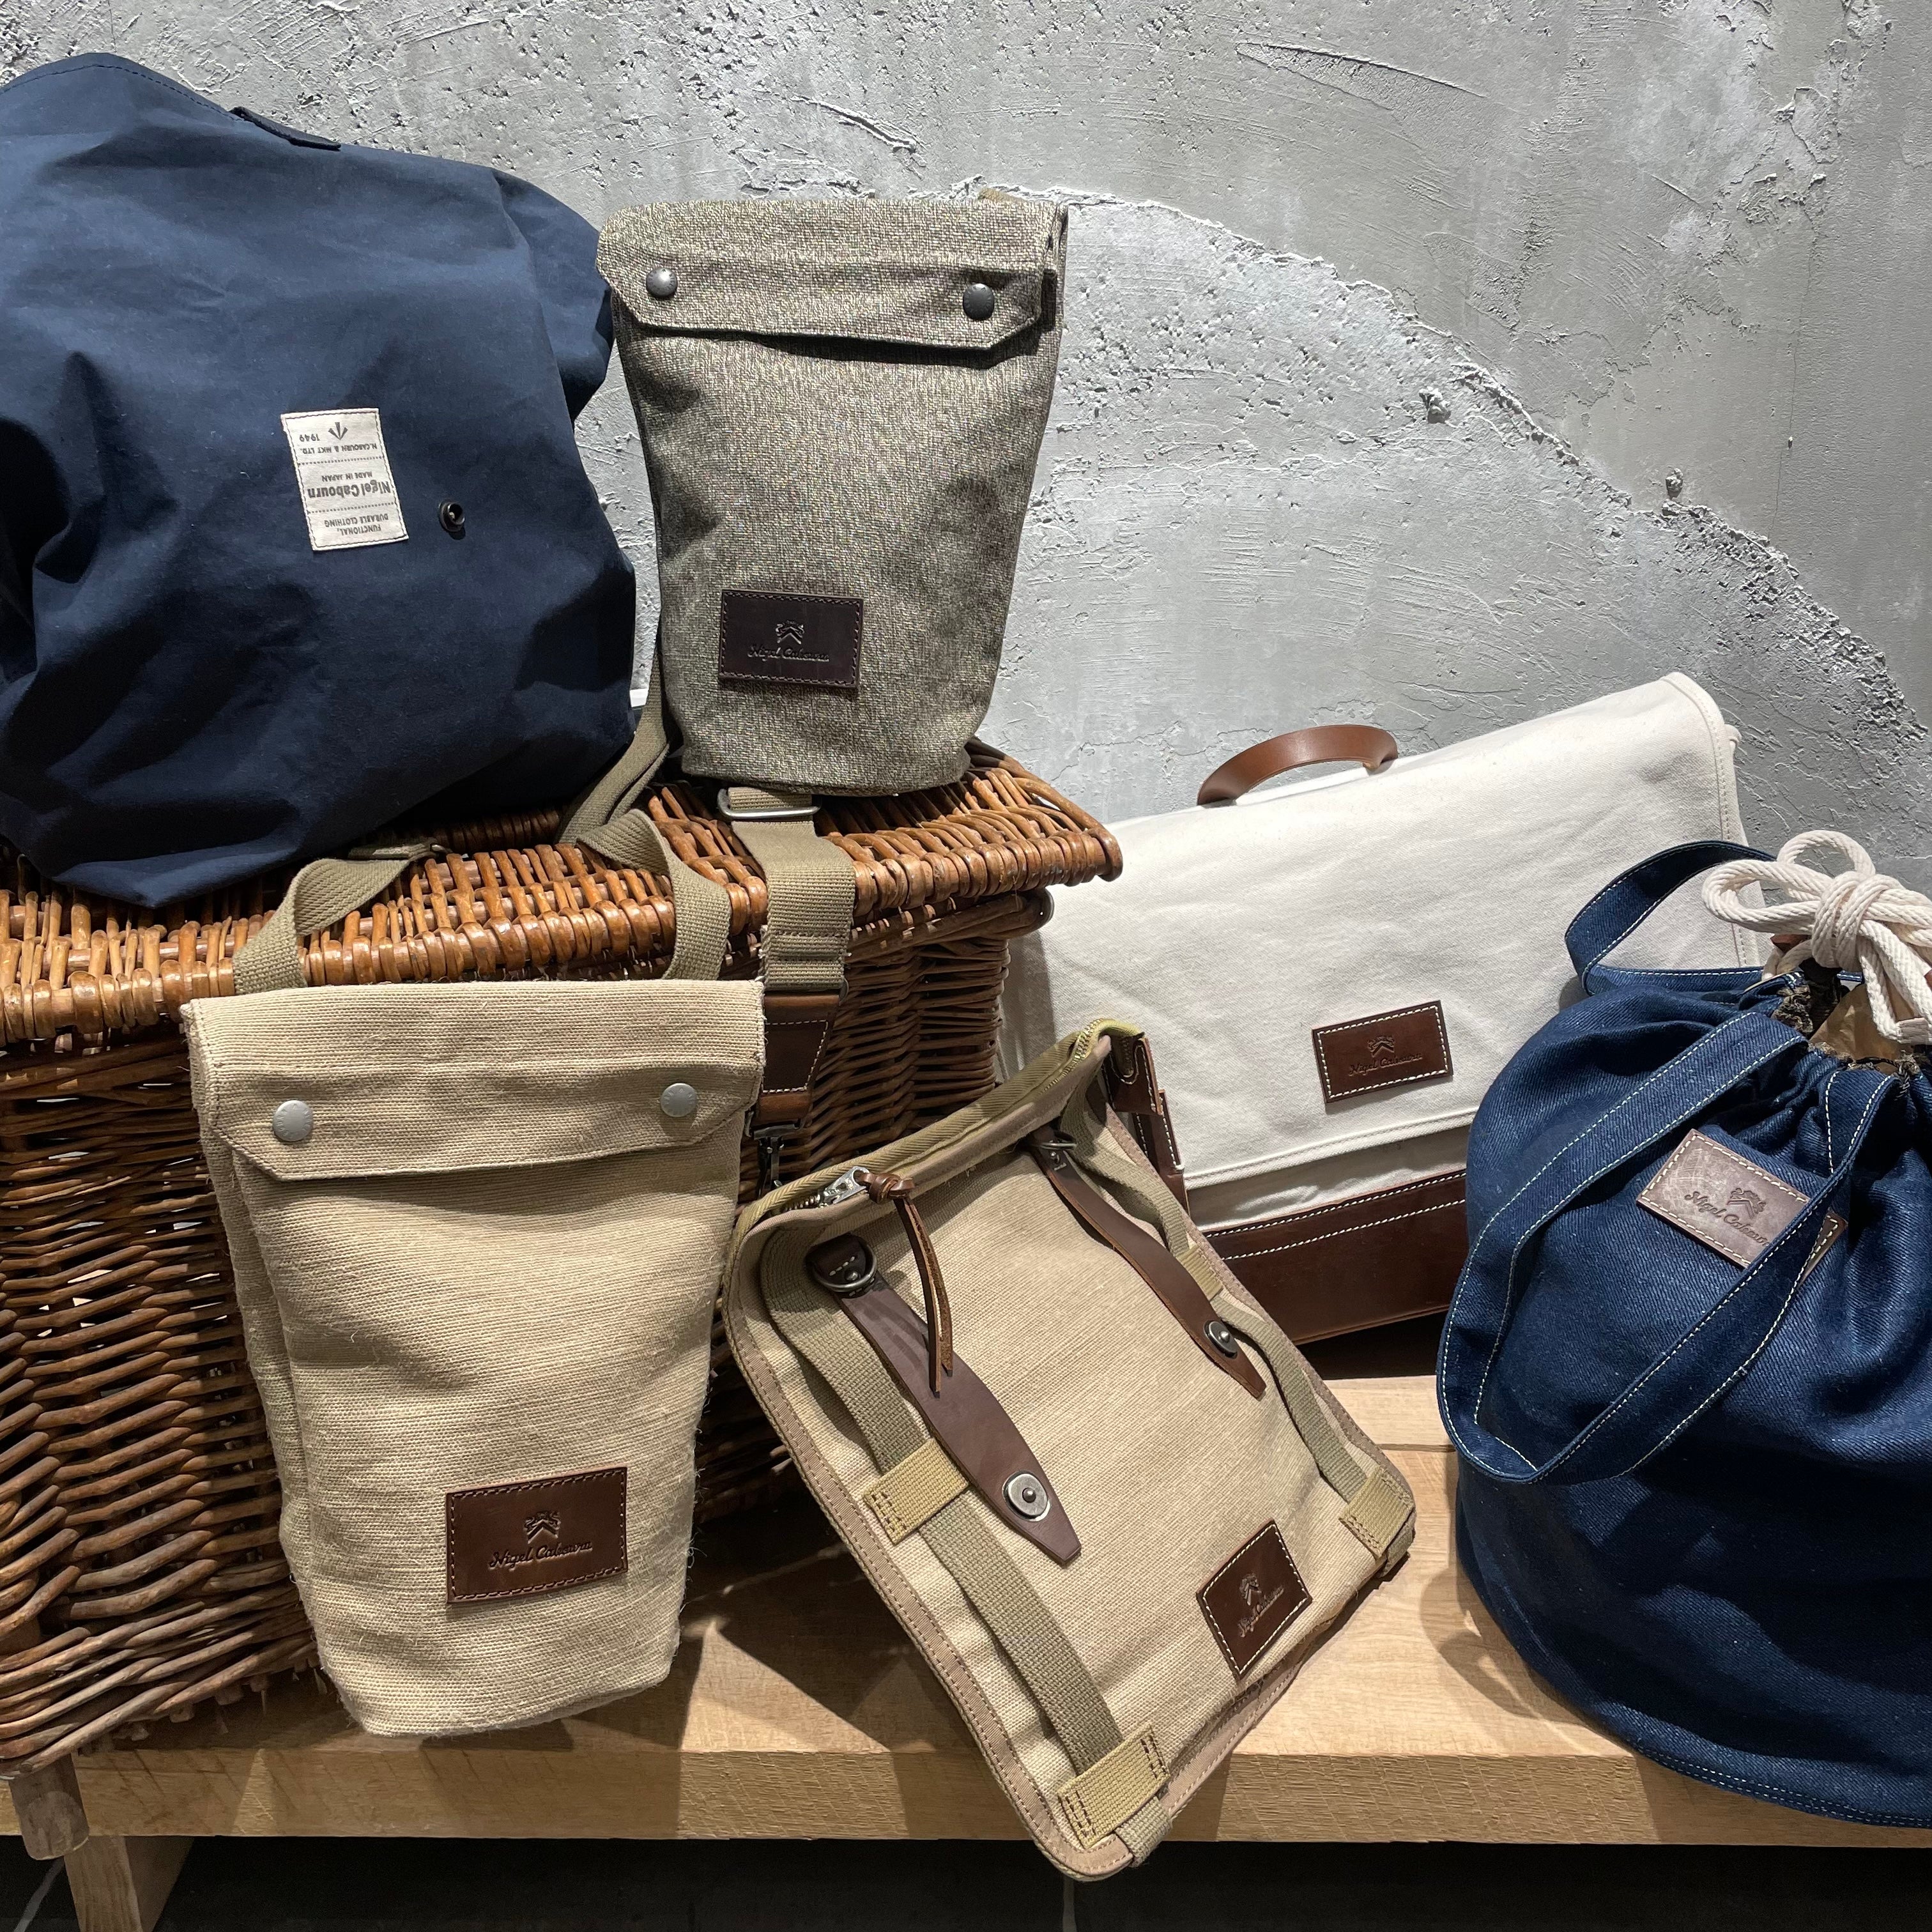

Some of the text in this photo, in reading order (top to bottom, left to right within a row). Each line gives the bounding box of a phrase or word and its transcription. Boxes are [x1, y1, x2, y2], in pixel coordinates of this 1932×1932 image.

[307, 480, 391, 498] Nigel Cabourn
[324, 514, 388, 527] DURABLE CLOTHING
[487, 1547, 533, 1571] Nigel
